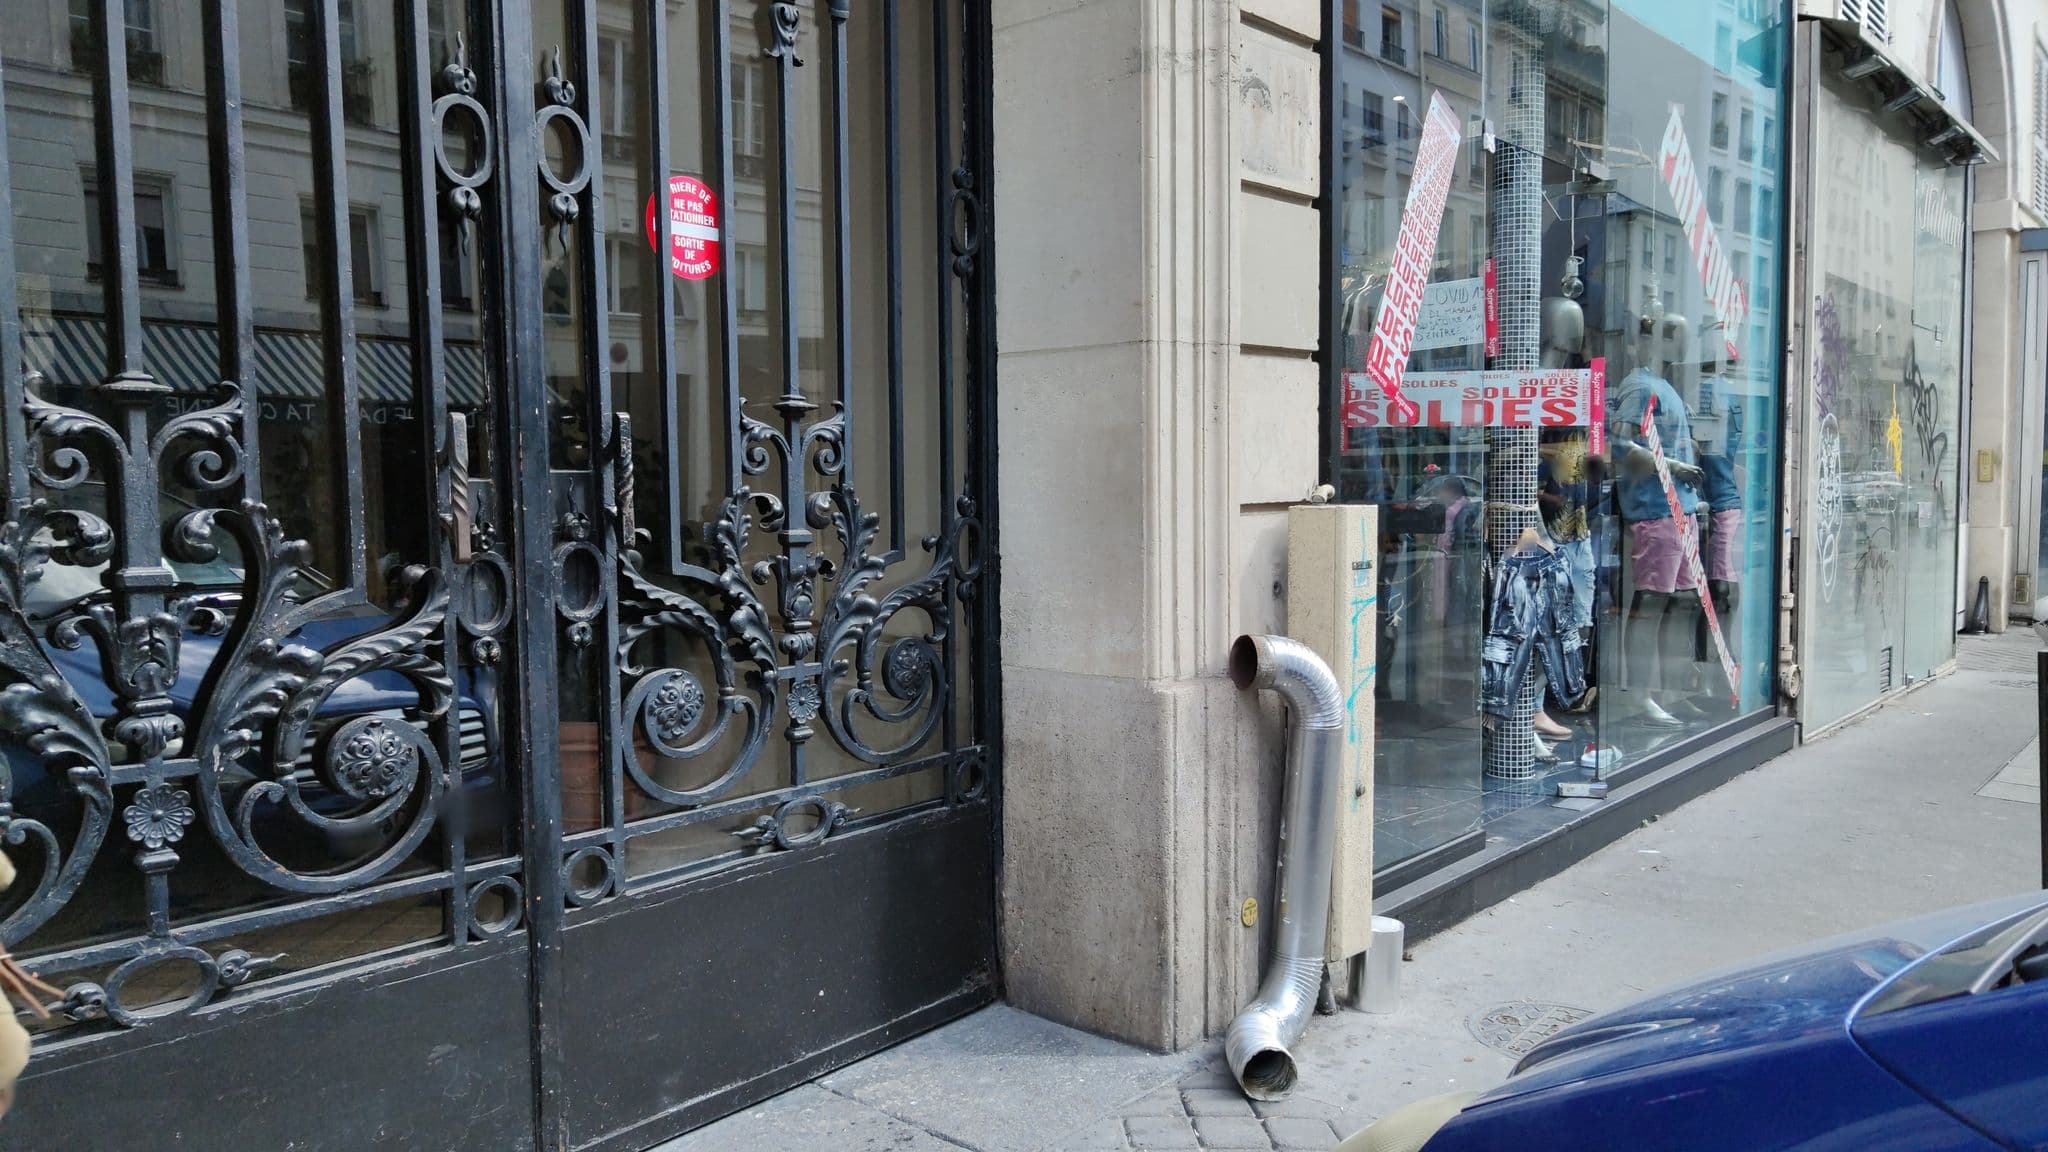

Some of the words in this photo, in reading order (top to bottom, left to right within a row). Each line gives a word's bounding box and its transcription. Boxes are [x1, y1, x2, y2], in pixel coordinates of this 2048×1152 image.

[670, 182, 697, 195] RIERE
[698, 189, 711, 204] DE
[674, 198, 686, 210] NE
[687, 200, 704, 213] PAS
[671, 209, 715, 226] TATIONNER
[1411, 198, 1437, 242] SOLDES
[1402, 208, 1434, 258] SOLDES
[674, 236, 705, 250] SORTIE
[685, 249, 696, 260] DE
[1376, 303, 1412, 358] DES
[1402, 379, 1458, 388] SOLDES
[1518, 378, 1579, 386] SOLDES
[1462, 386, 1579, 399] SOLDES
[1592, 372, 1603, 406] Supreme
[1347, 399, 1577, 428] SOLDES
